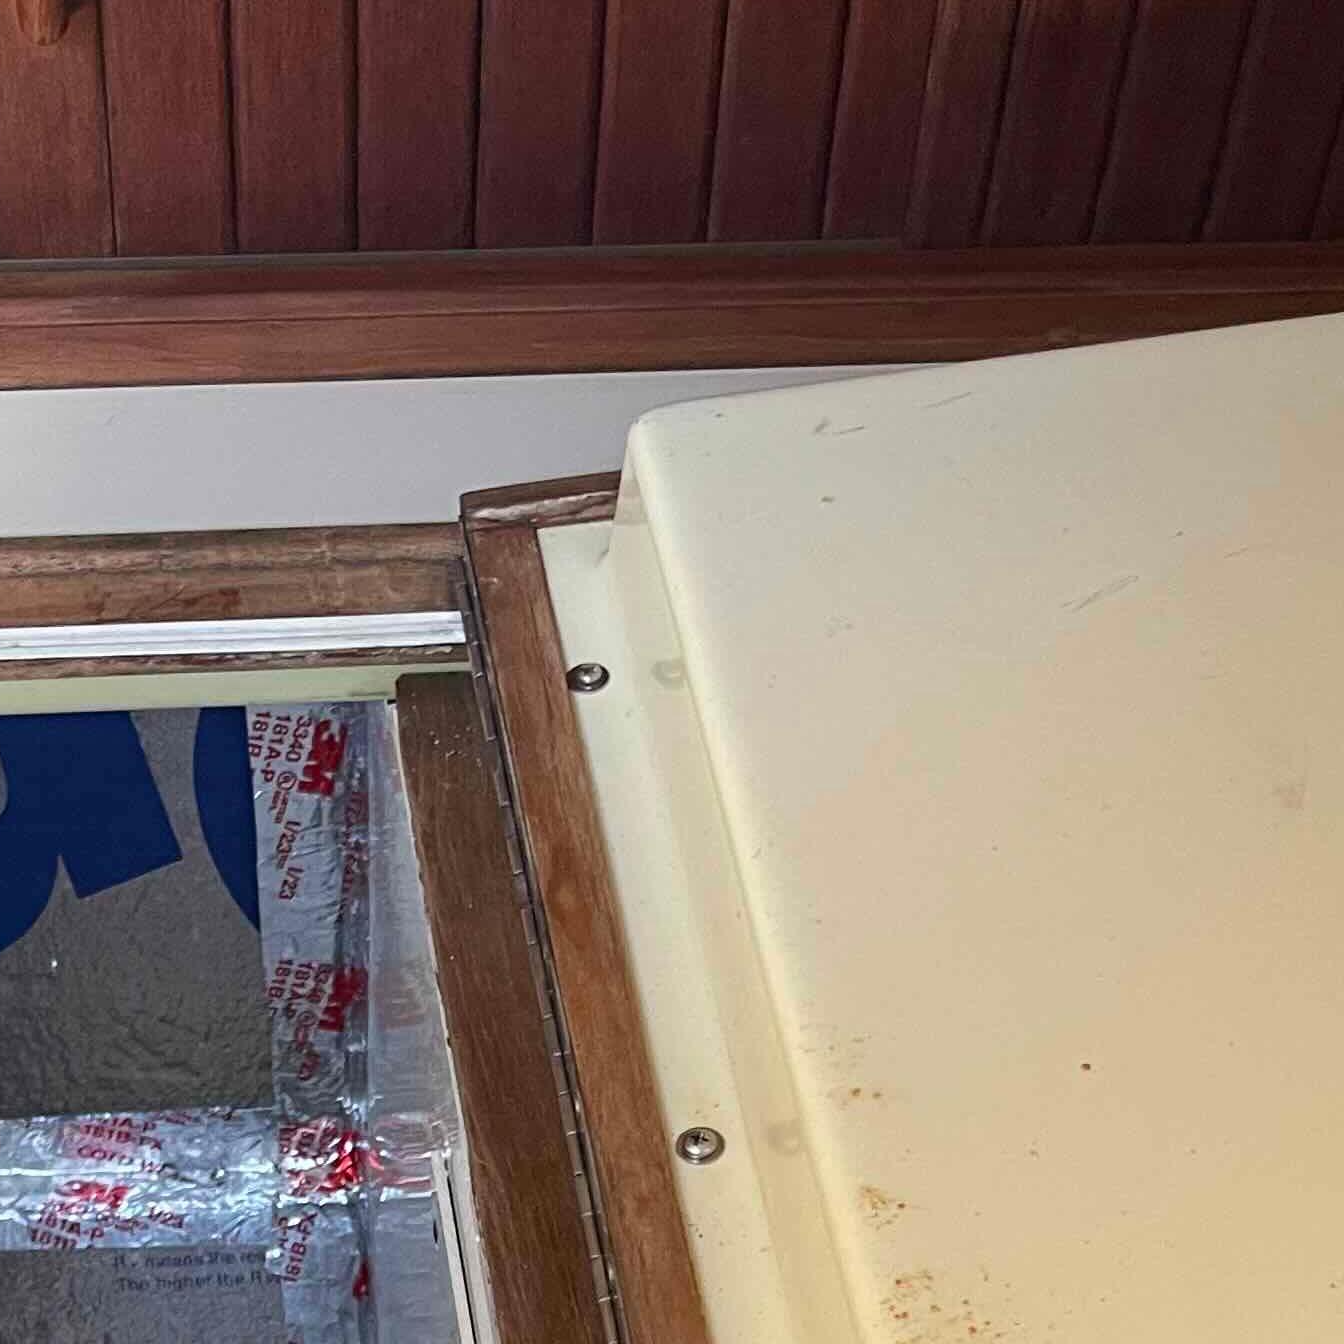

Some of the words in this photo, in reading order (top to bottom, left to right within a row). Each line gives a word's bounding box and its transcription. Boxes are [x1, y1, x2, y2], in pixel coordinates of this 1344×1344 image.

[261, 715, 290, 783] 181A-P
[287, 715, 312, 762] 3340
[296, 719, 348, 795] 3M
